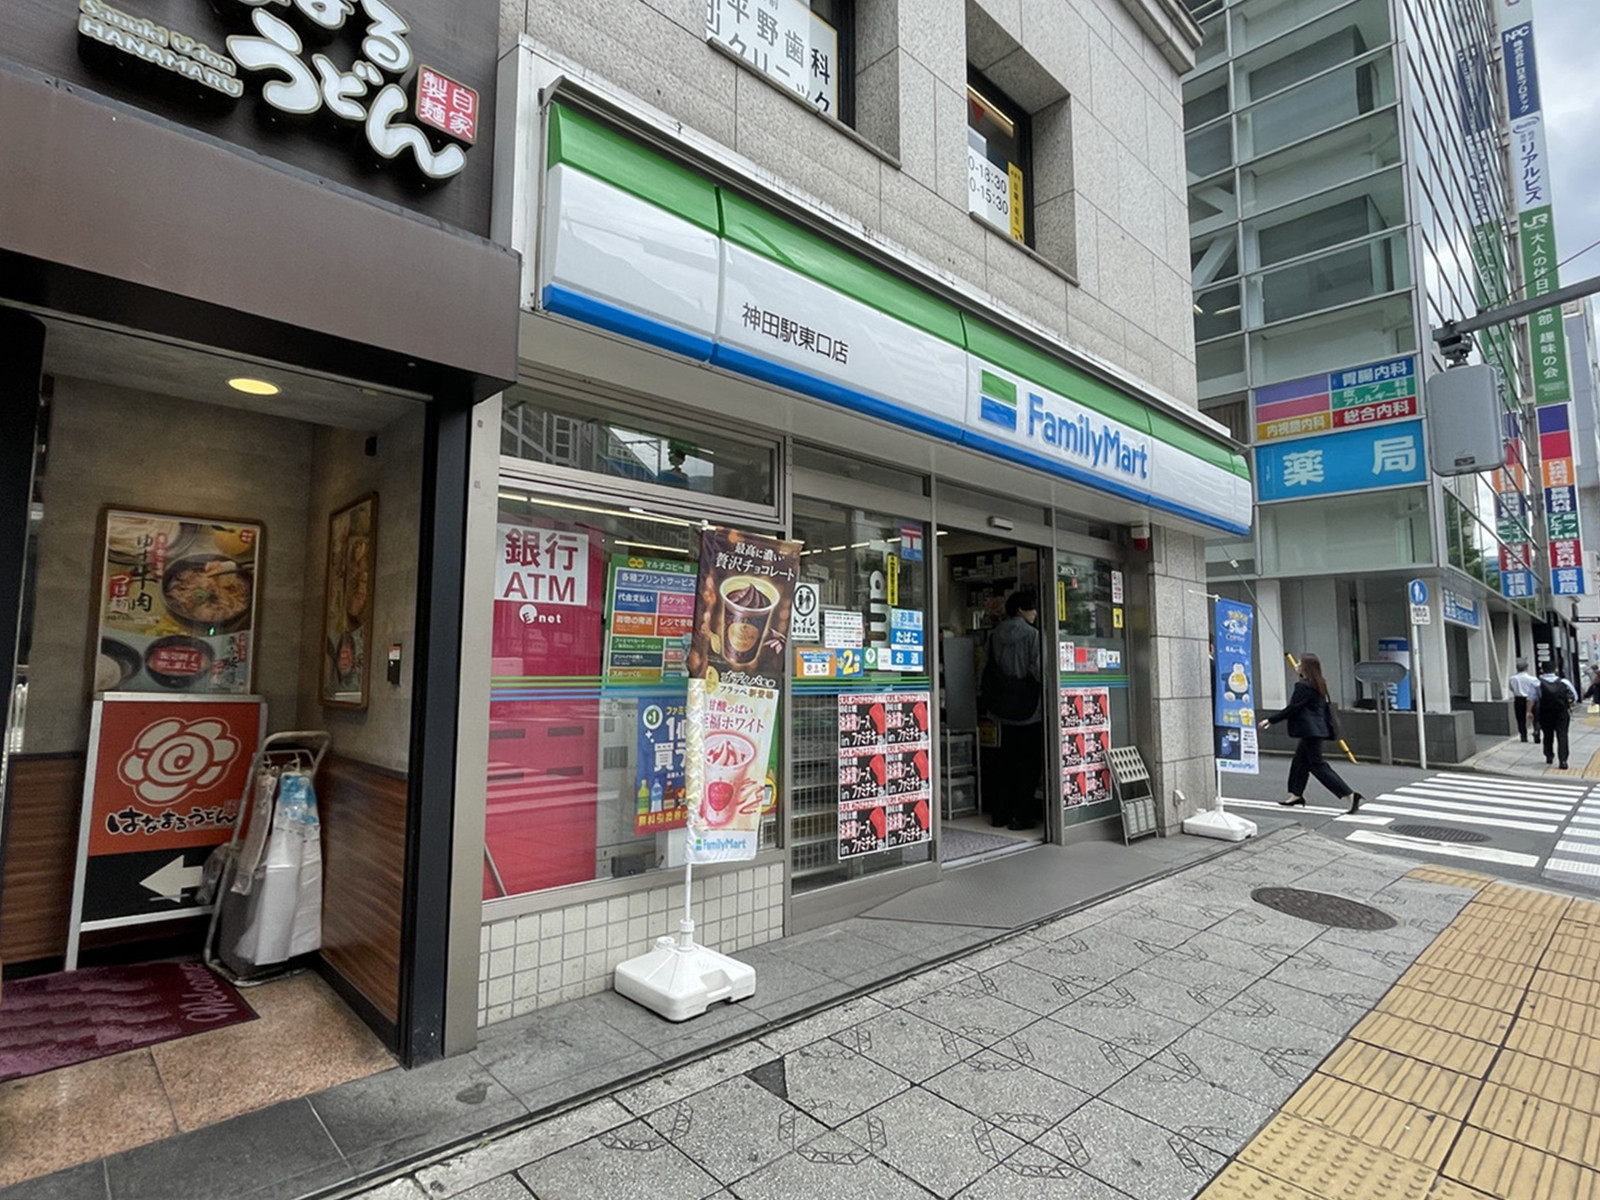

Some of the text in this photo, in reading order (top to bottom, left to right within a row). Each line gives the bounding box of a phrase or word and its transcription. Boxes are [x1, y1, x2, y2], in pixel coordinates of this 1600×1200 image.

[82, 0, 235, 75] Sanuki Udon
[1504, 26, 1530, 42] NPC
[81, 16, 242, 96] HANAMARU
[226, 8, 466, 179] うどん
[1520, 141, 1542, 205] リアルビス
[1522, 212, 1549, 229] JR
[741, 302, 849, 365] 神田駅東口店
[1343, 399, 1410, 424] 総合内科
[1028, 391, 1148, 480] FamilyMart
[505, 527, 579, 571] 銀行
[715, 551, 795, 582] 贅沢チョコレート
[503, 571, 576, 602] ATM
[708, 699, 754, 715] 甘酸っぱい
[105, 805, 239, 835] はなまるうどん
